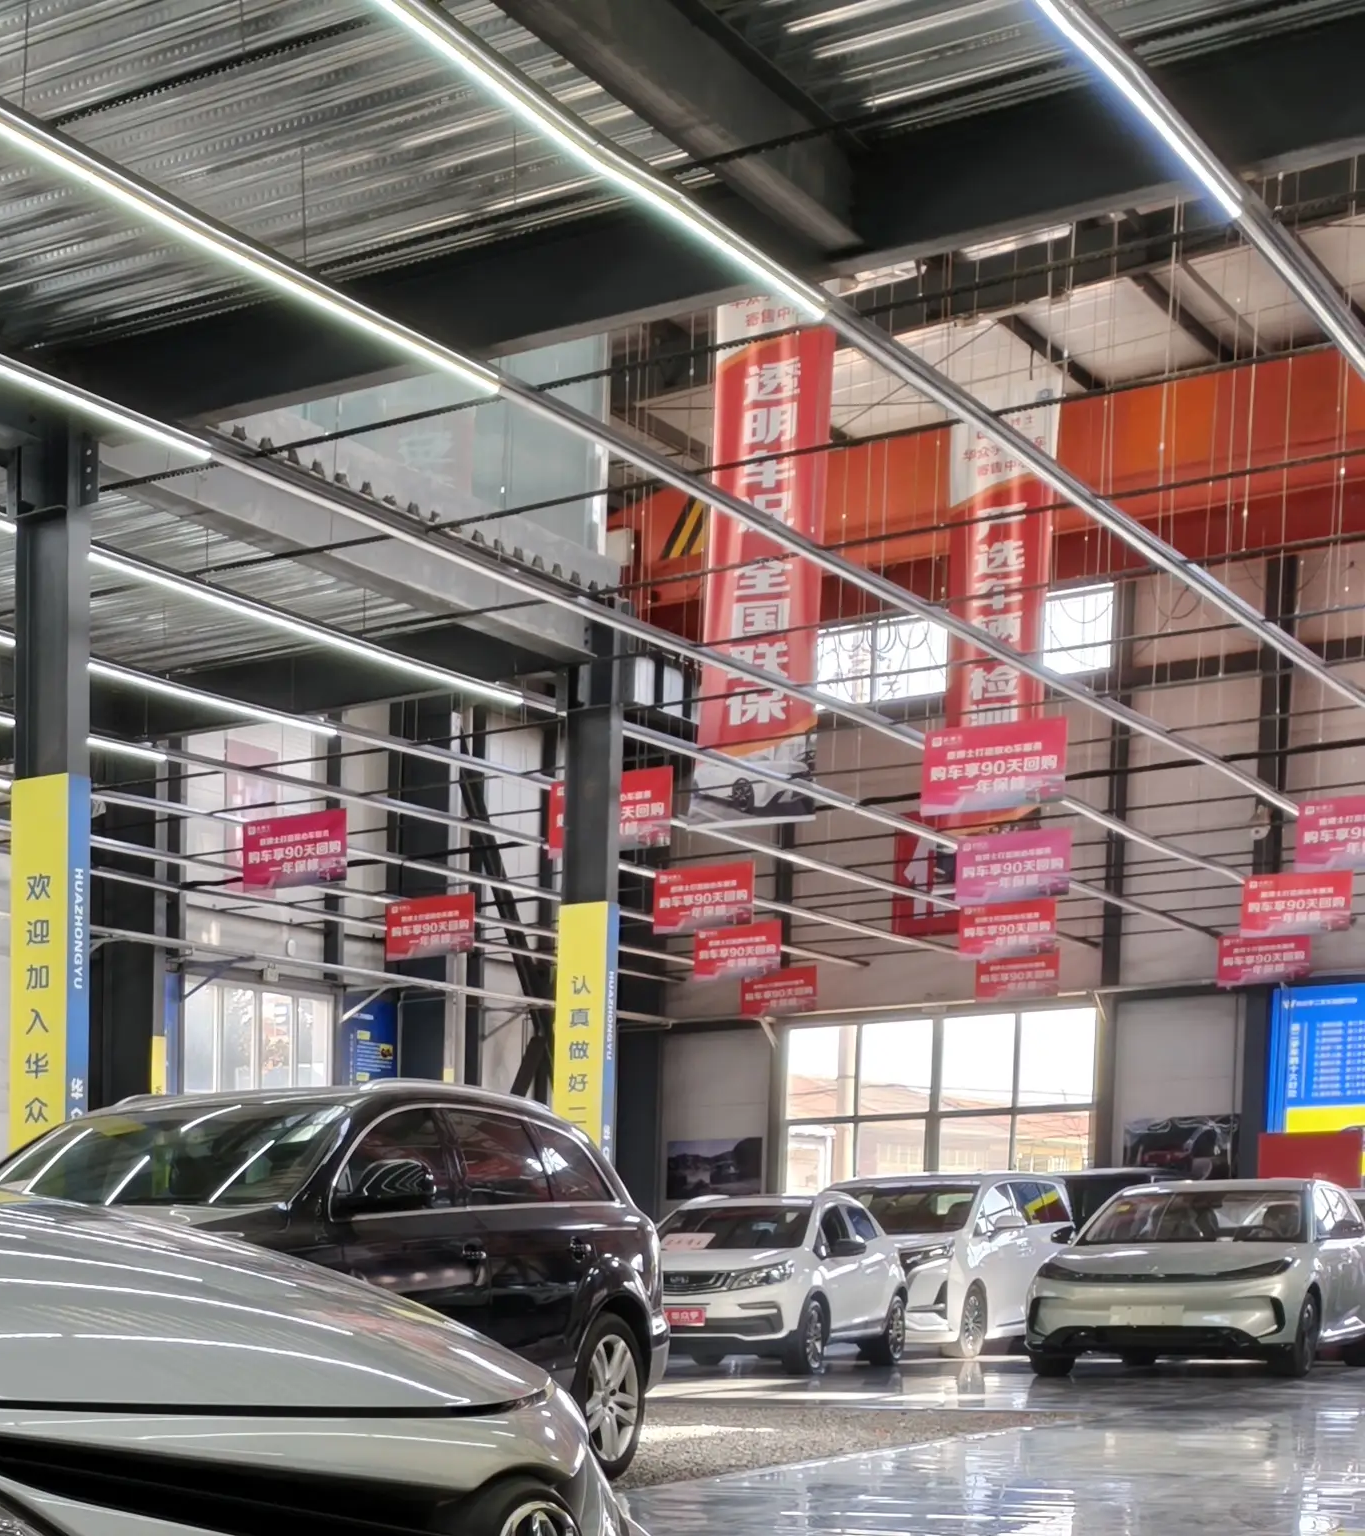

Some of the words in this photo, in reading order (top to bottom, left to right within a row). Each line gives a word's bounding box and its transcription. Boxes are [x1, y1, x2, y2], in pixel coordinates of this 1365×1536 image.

[930, 754, 1058, 782] 购车享90天回购
[248, 840, 342, 864] 购车享90天回购
[73, 867, 84, 990] HUAZHONGYU
[25, 873, 51, 1124] 欢迎加入华众
[568, 975, 591, 1124] 认真做好二
